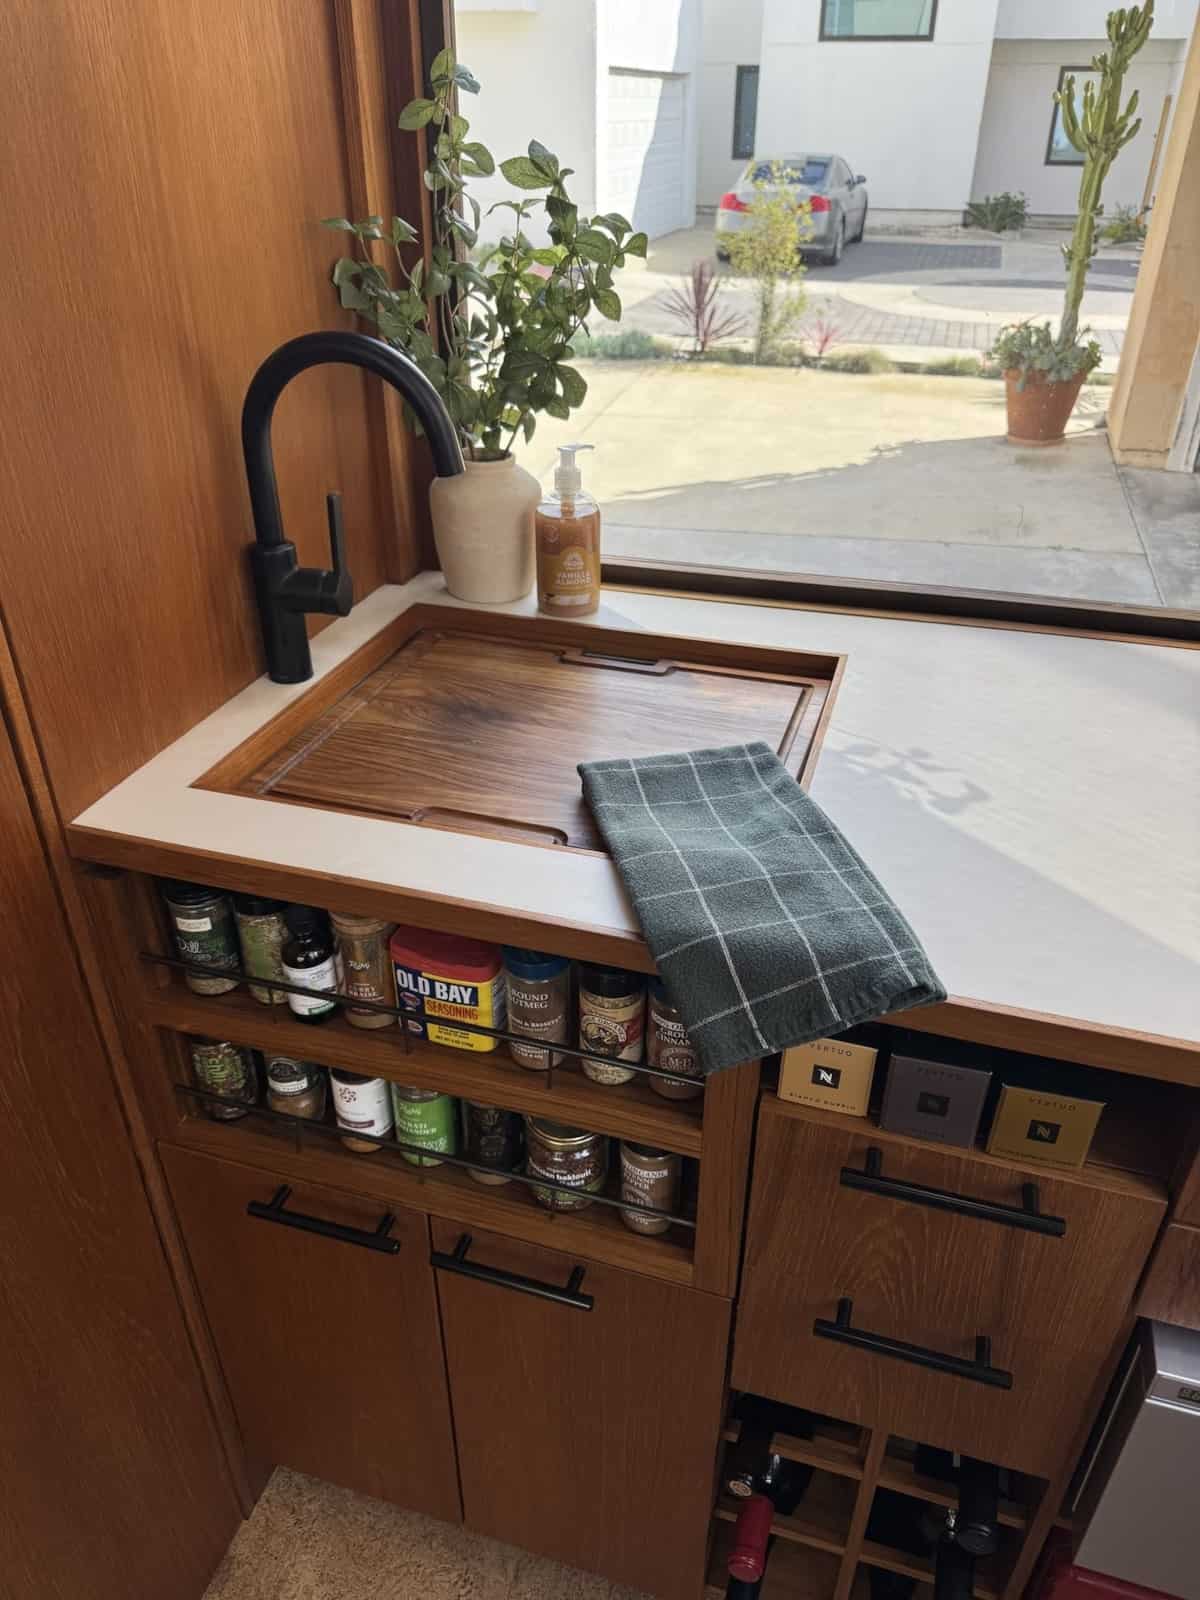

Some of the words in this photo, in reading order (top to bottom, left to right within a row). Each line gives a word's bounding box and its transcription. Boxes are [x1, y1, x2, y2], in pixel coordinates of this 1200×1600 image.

[396, 968, 430, 996] OLD
[434, 981, 473, 1005] BAY
[426, 999, 479, 1021] SEASONING
